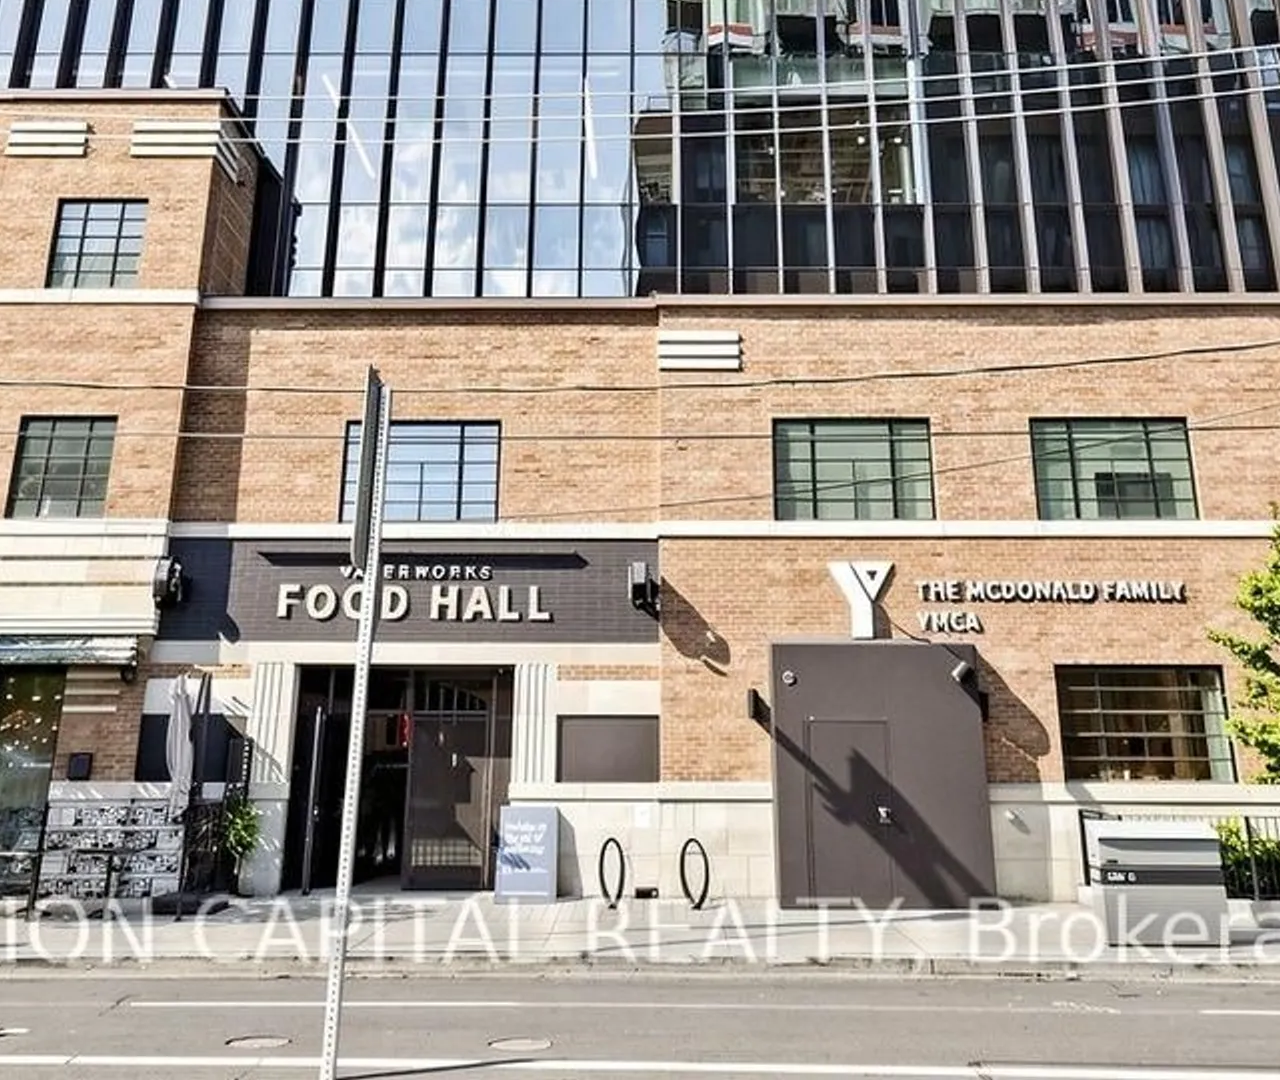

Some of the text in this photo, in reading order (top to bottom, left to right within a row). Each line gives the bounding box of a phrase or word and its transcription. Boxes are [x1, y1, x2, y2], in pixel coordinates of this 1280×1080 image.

[339, 564, 494, 580] WAERWORKS
[276, 583, 553, 621] FOOD HALL
[915, 580, 1187, 603] THE MCDONALD FAMILY
[916, 611, 984, 634] YMCA
